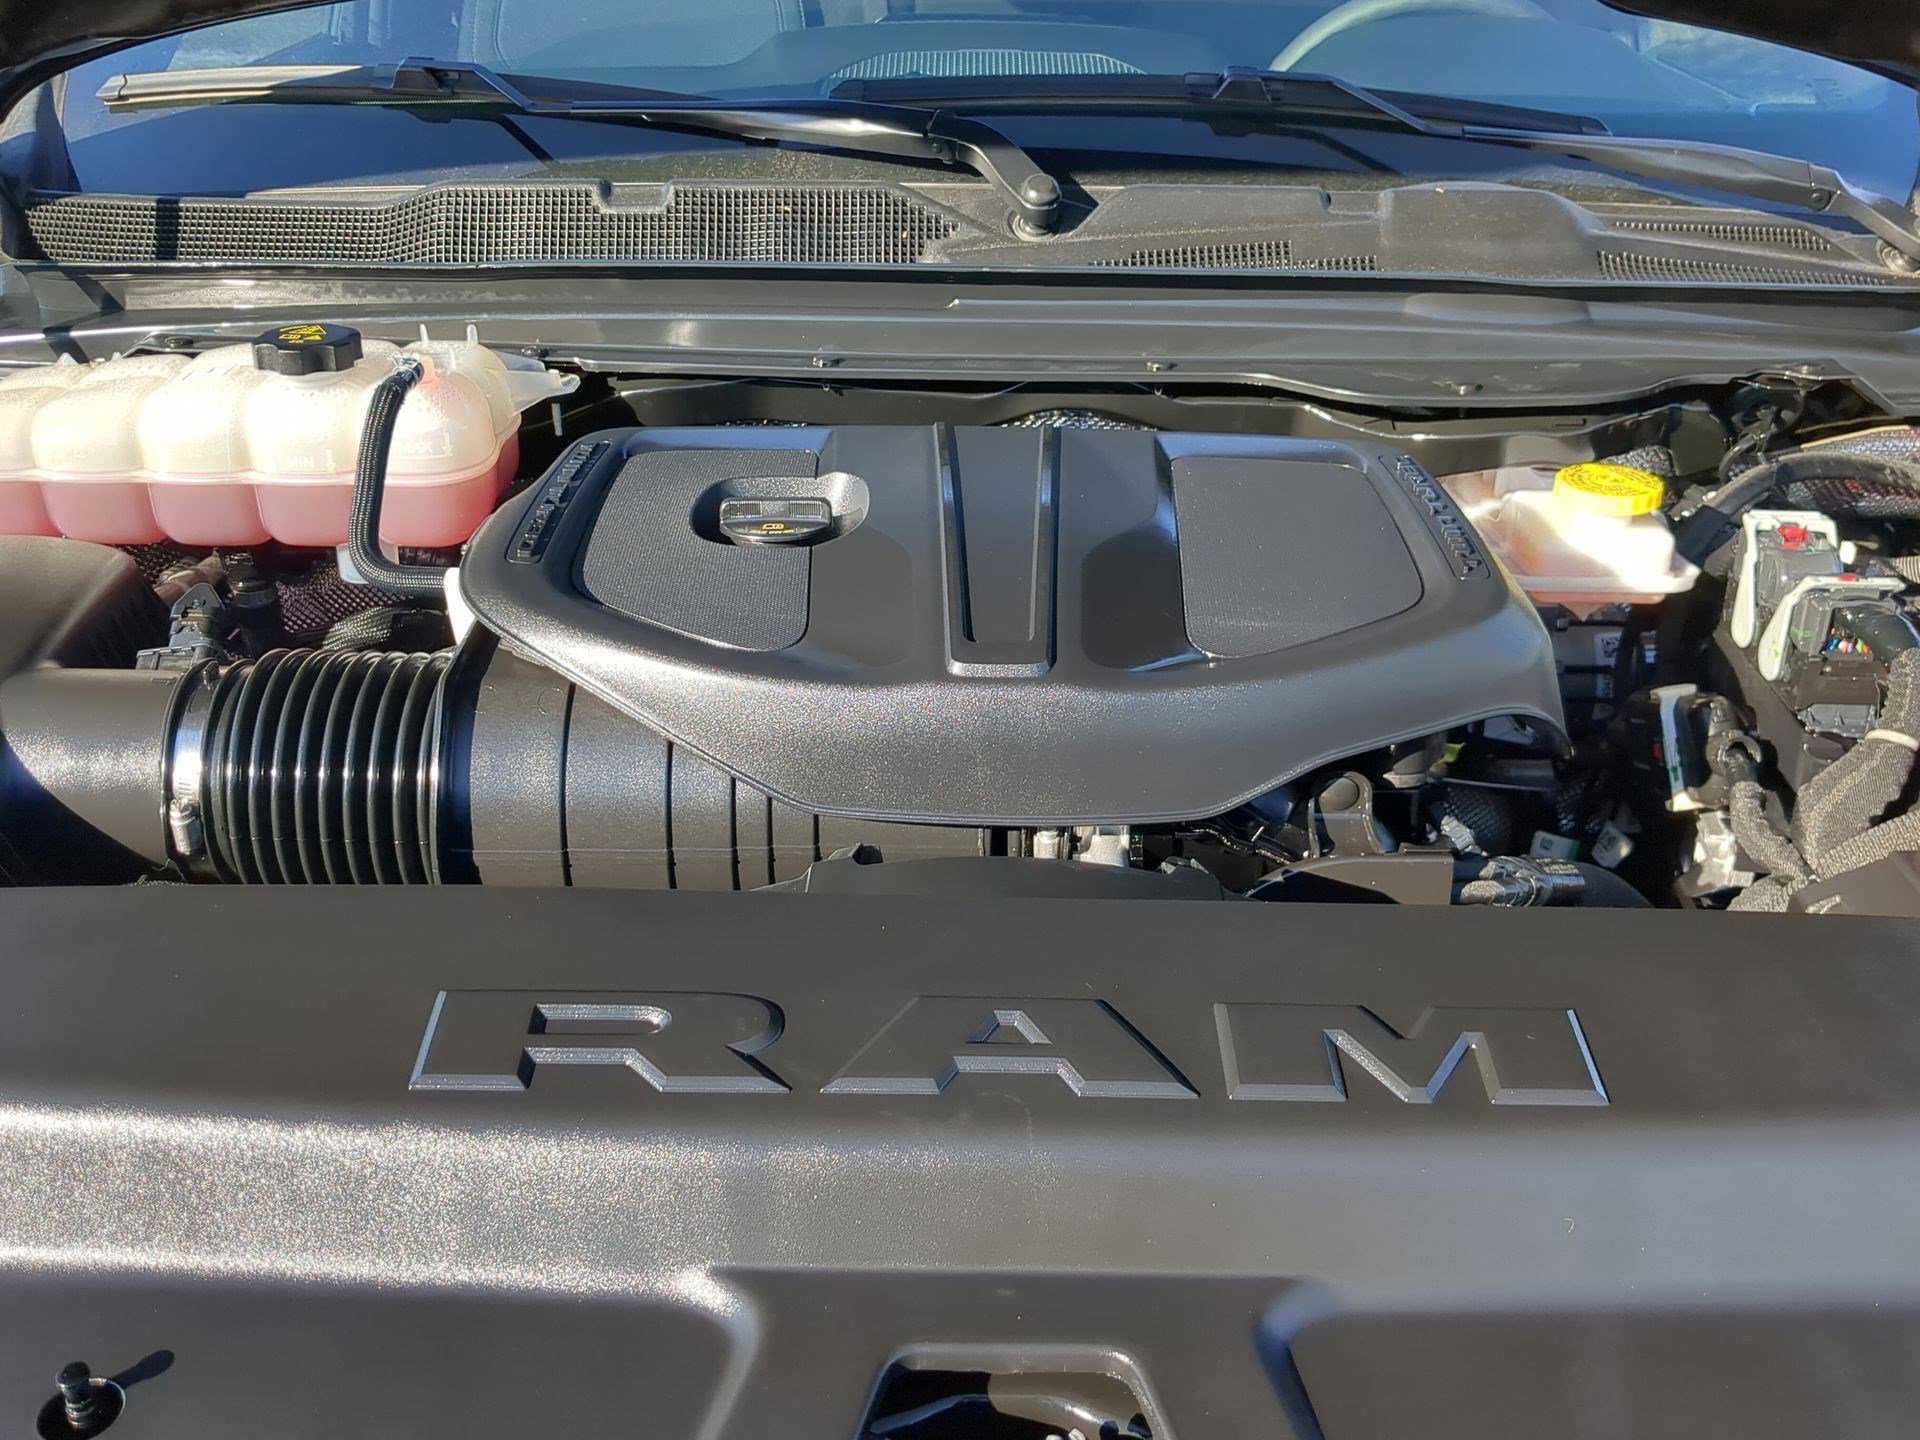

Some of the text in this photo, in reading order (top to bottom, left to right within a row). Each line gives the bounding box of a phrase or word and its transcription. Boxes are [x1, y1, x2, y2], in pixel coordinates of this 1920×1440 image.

[400, 440, 433, 454] MAX
[286, 455, 314, 469] MIN
[408, 989, 1611, 1106] RAM
